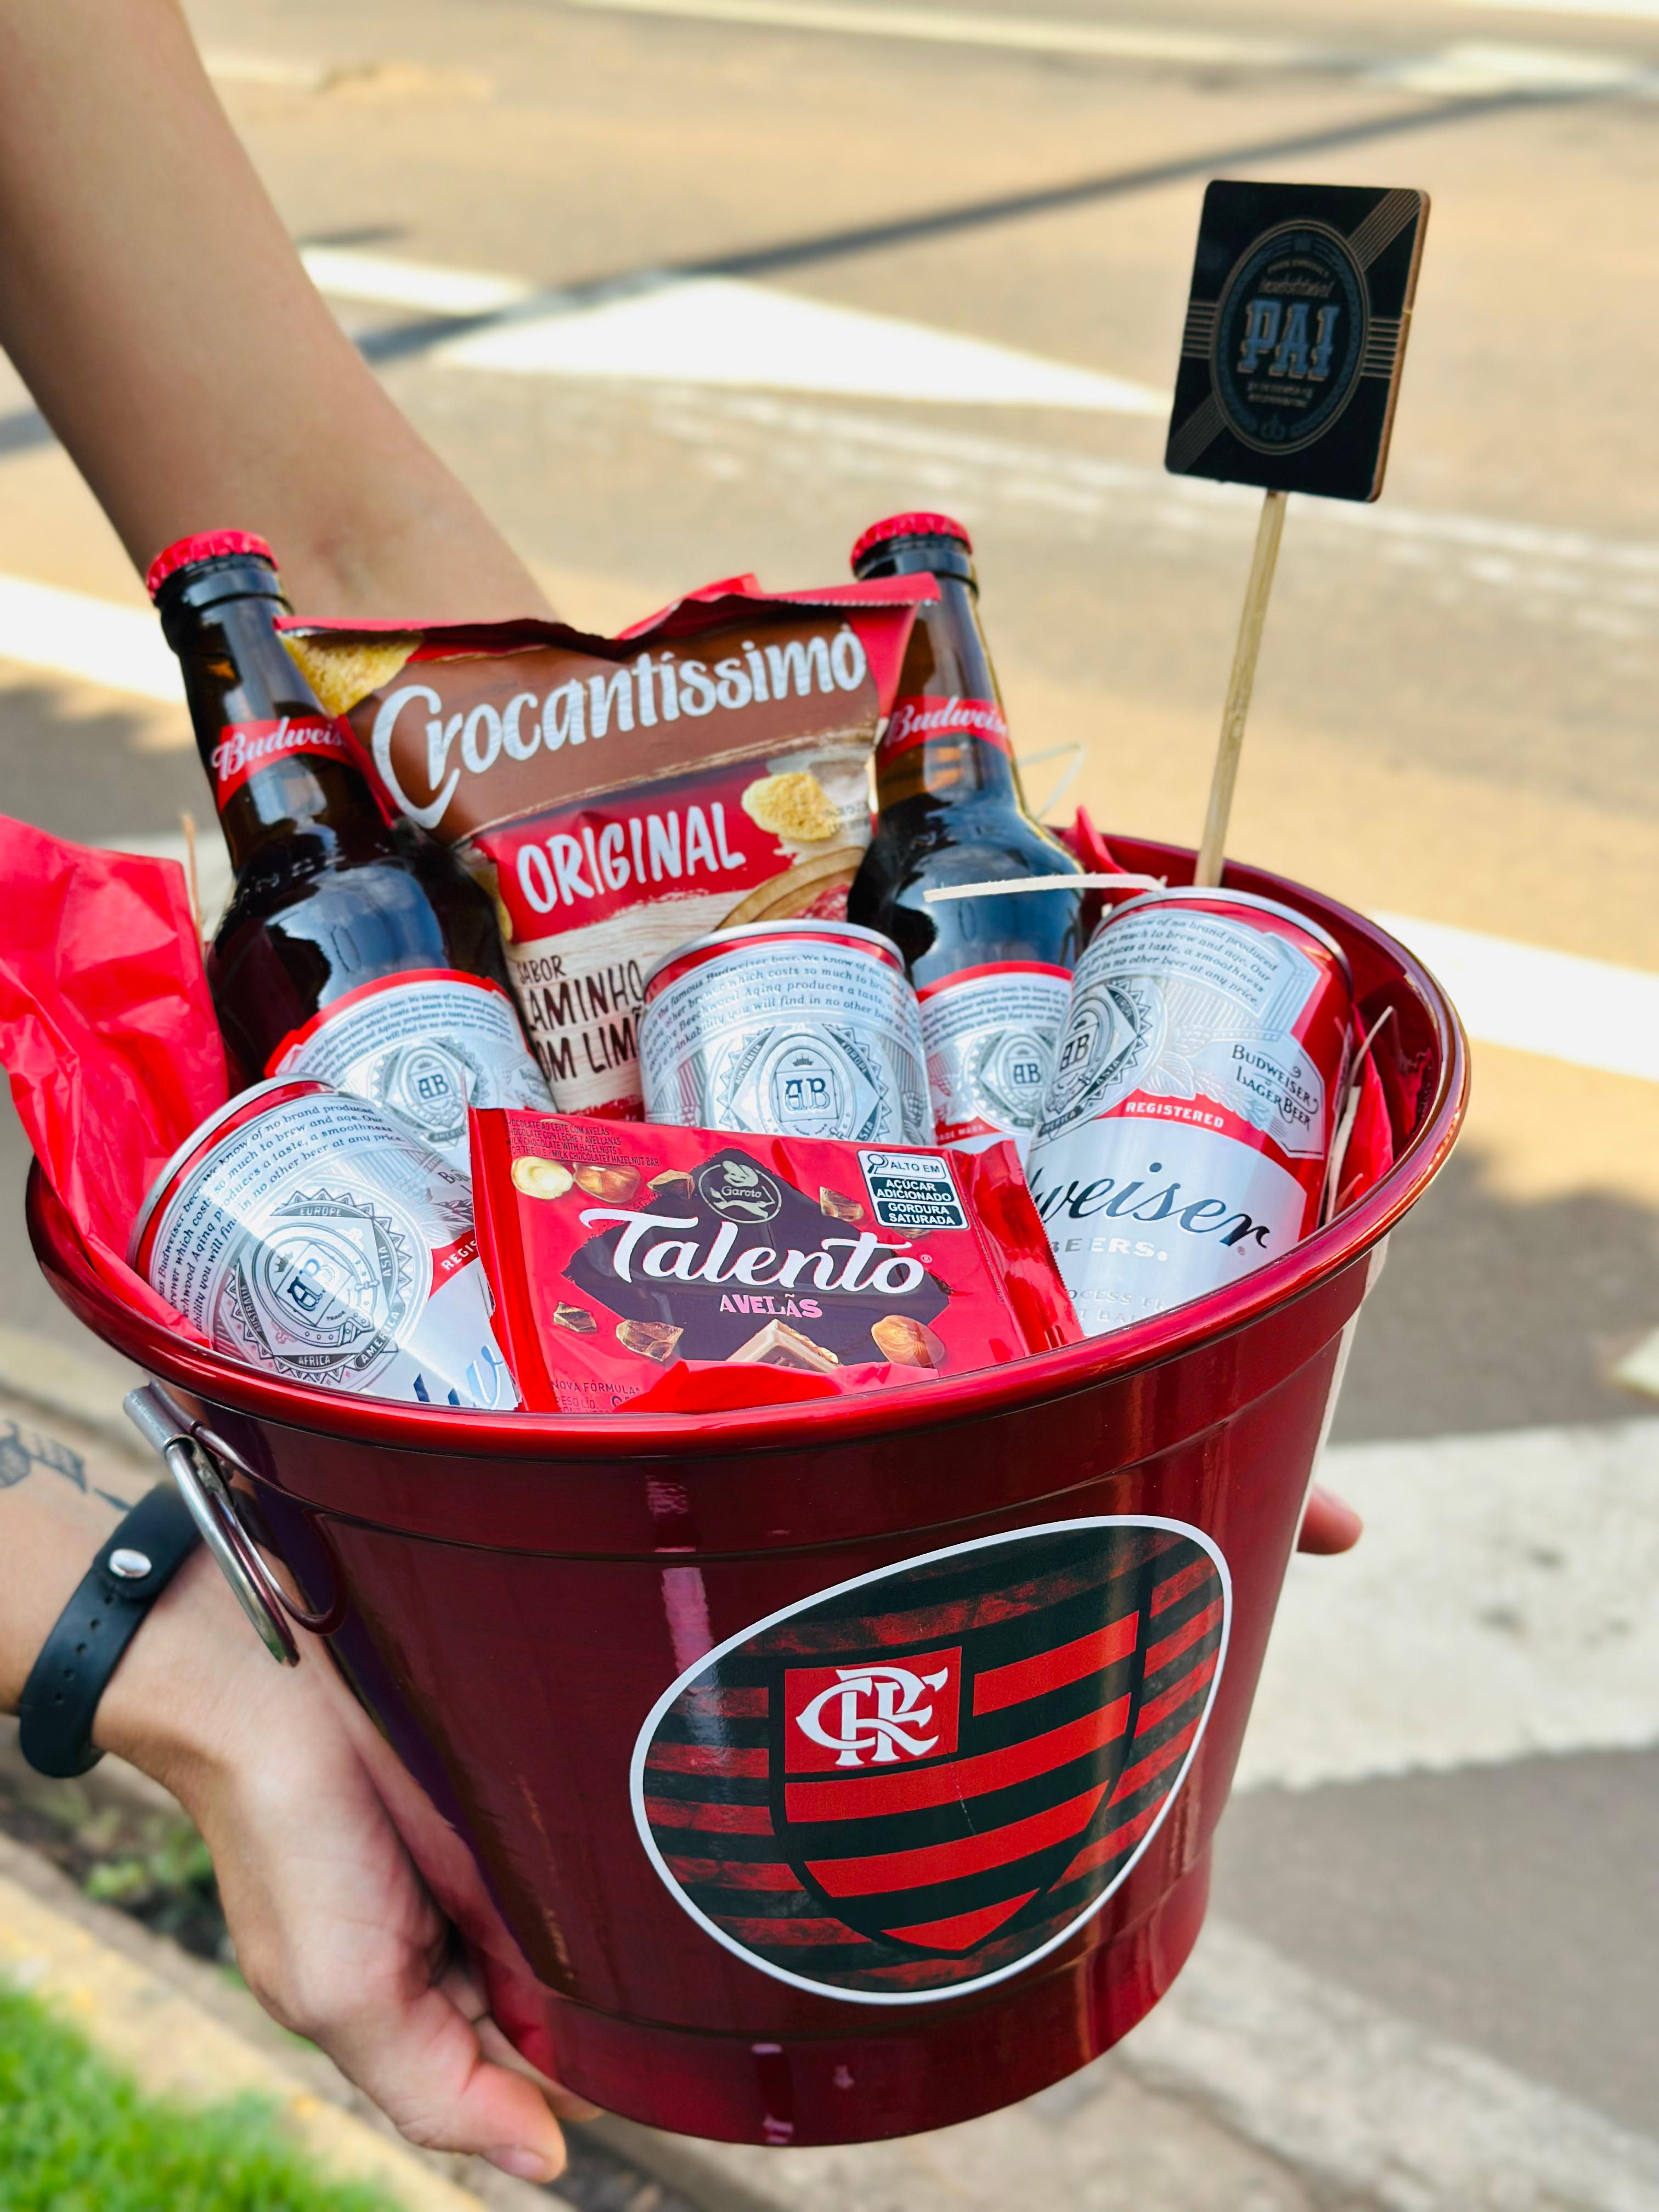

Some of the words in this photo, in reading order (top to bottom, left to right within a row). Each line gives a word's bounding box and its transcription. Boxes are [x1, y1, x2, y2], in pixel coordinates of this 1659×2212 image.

[1237, 299, 1340, 382] PAI
[884, 695, 1007, 748] Budweis
[211, 716, 347, 781] Budweis
[517, 802, 747, 913] ORIGINAL
[1166, 930, 1196, 942] brew
[1198, 939, 1223, 952] and
[1250, 964, 1271, 982] Our
[1189, 922, 1226, 939] brand
[1226, 936, 1278, 971] produced
[517, 955, 567, 985] SABOR
[1129, 955, 1159, 964] other
[1161, 956, 1188, 968] beer
[1189, 966, 1204, 974] at
[1205, 970, 1228, 985] any
[1229, 983, 1257, 1007] price.
[1148, 942, 1180, 954] taste,
[1194, 951, 1264, 992] smoothness
[529, 960, 643, 1031] AMINHO
[658, 1006, 669, 1020] the
[671, 981, 704, 1008] famous
[706, 958, 766, 983] Budweiser
[823, 955, 853, 966] know
[855, 963, 866, 972] of
[869, 967, 880, 977] no
[665, 1005, 686, 1028] other
[729, 969, 763, 987] which
[769, 967, 799, 977] costs
[822, 968, 852, 980] much
[856, 974, 867, 984] to
[870, 978, 891, 996] brew
[679, 991, 740, 1031] Beechwood
[746, 983, 781, 996] Aging
[787, 980, 844, 992] produces
[858, 988, 885, 1008] taste,
[728, 1006, 749, 1019] you
[754, 998, 775, 1010] will
[780, 995, 804, 1007] find
[843, 1000, 871, 1014] other
[874, 1010, 893, 1025] beer
[536, 1037, 578, 1082] OM
[583, 1005, 641, 1074] LIM
[417, 1074, 450, 1100] AB
[1013, 1063, 1041, 1084] AB
[1232, 1044, 1311, 1108] BUDWEISER
[785, 1077, 831, 1111] AB
[551, 1123, 569, 1133] LEITE
[571, 1125, 584, 1134] COM
[1126, 1101, 1224, 1129] REGISTERED
[1284, 1097, 1311, 1132] BEER
[509, 1128, 541, 1139] HOCOLATE
[543, 1131, 556, 1140] CON
[558, 1132, 578, 1142] LECHE
[585, 1136, 622, 1146] AVELLANAS
[524, 1138, 562, 1150] CHOCOLATE
[562, 1142, 578, 1152] WITH
[580, 1144, 617, 1155] HAZELNUTS
[522, 1145, 535, 1155] THE
[552, 1150, 568, 1159] MILK
[569, 1150, 610, 1163] CHOCOLATEY
[612, 1155, 645, 1166] HAZELNUT
[646, 1156, 659, 1166] BAR
[890, 1161, 920, 1171] ALTO
[923, 1164, 940, 1173] EM
[159, 1213, 184, 1278] Budweiser
[219, 1138, 248, 1165] know
[251, 1126, 263, 1141] of
[265, 1120, 281, 1132] no
[283, 1105, 320, 1123] brand
[323, 1104, 375, 1115] produced
[176, 1229, 194, 1266] which
[215, 1180, 226, 1194] so
[228, 1151, 258, 1178] much
[259, 1140, 274, 1152] to
[275, 1124, 306, 1143] brew
[309, 1115, 332, 1128] and
[363, 1114, 384, 1124] Our
[192, 1222, 216, 1262] Aging
[263, 1160, 272, 1169] a
[273, 1139, 308, 1161] taste,
[321, 1123, 393, 1137] smoothness
[721, 1185, 763, 1198] Garoto
[876, 1188, 952, 1202] ADICIONADO
[1034, 1162, 1271, 1249] weiser
[199, 1266, 212, 1290] you
[208, 1238, 223, 1263] will
[252, 1183, 268, 1198] no
[270, 1157, 301, 1183] other
[302, 1144, 329, 1161] beer
[332, 1137, 344, 1148] at
[348, 1135, 371, 1144] any
[374, 1133, 406, 1143] price.
[300, 1207, 342, 1217] EUROPE
[887, 1202, 950, 1215] GORDURA
[888, 1212, 956, 1226] SATURADA
[377, 1245, 392, 1278] ASIA
[441, 1239, 477, 1271] REGIS
[579, 1207, 928, 1294] Talento
[719, 1293, 823, 1318] AVELÃS
[1068, 1289, 1132, 1305] OCESS
[360, 1311, 401, 1364] AMERICA
[298, 1355, 332, 1367] AFRICA
[551, 1380, 581, 1391] NOVA
